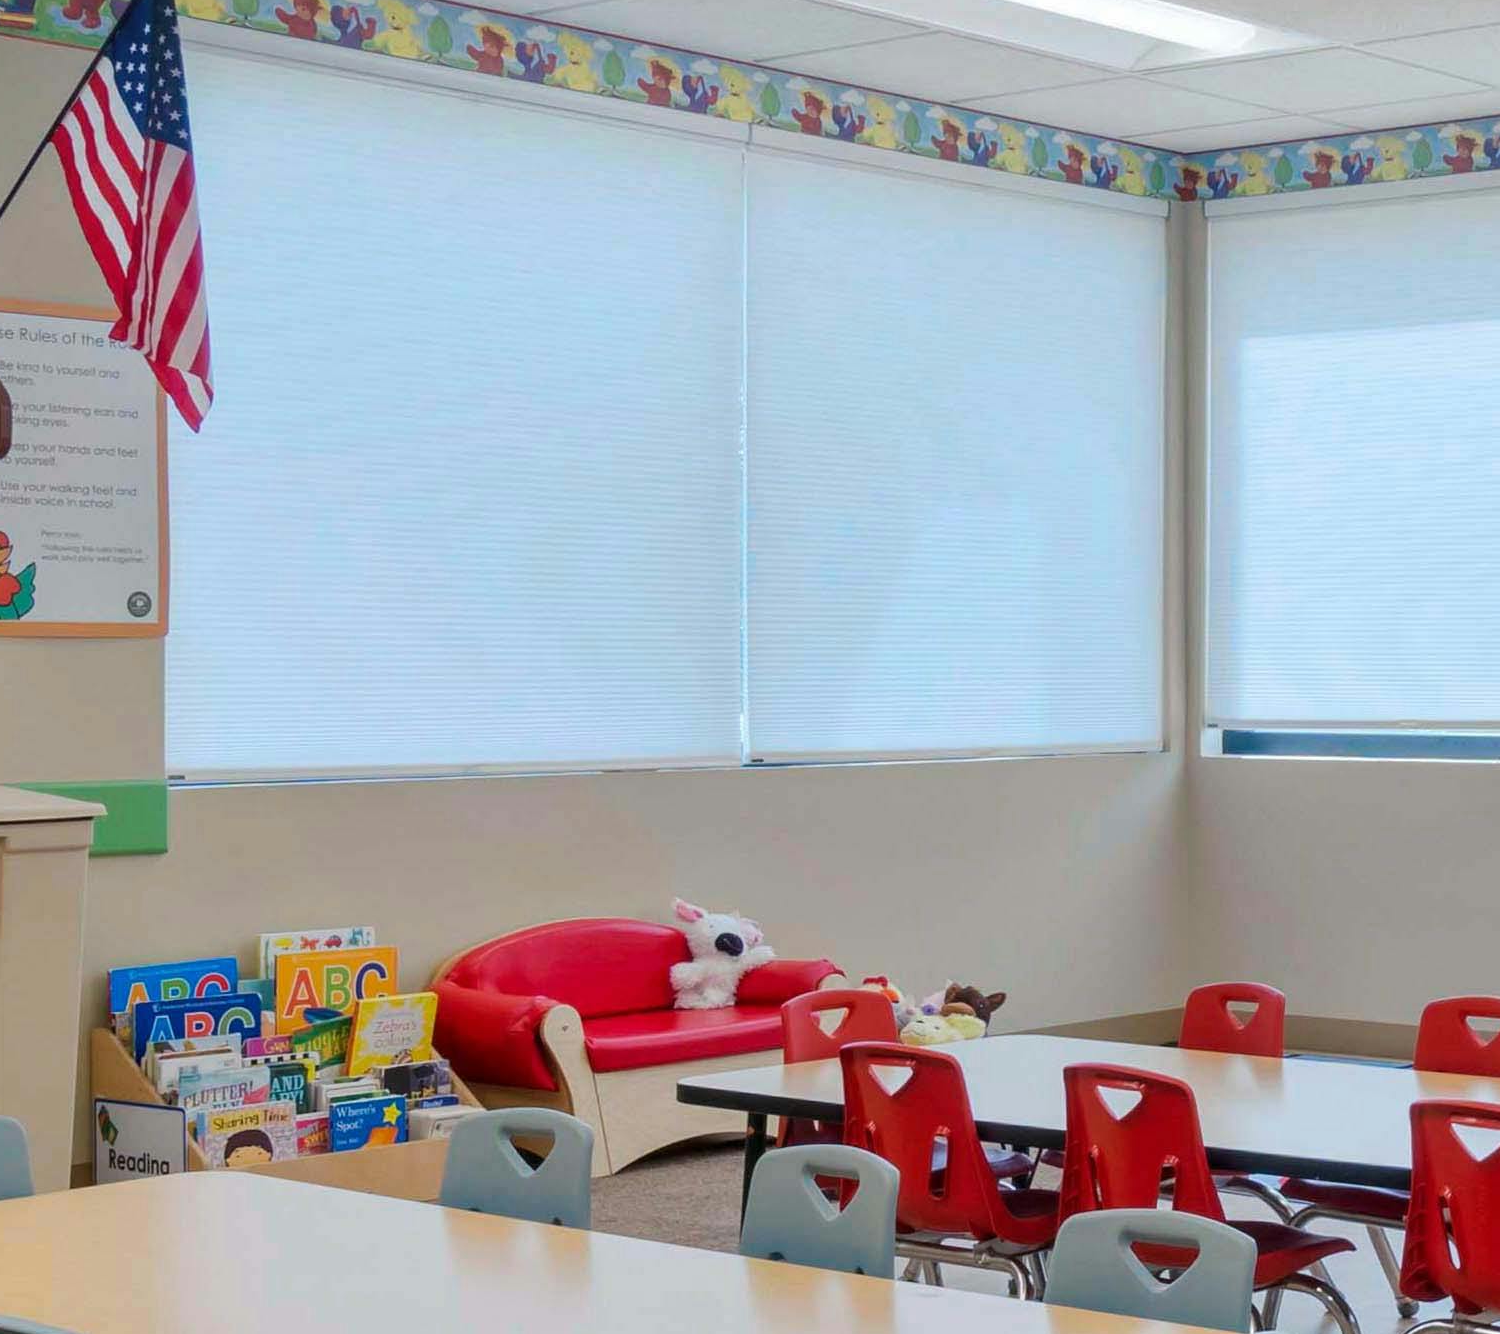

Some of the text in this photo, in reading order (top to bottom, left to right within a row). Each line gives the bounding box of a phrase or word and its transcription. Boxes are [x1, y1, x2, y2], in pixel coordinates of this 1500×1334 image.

[19, 327, 58, 343] Rules
[62, 331, 76, 345] of
[81, 333, 105, 348] the
[56, 364, 96, 378] yourself
[98, 367, 121, 380] and
[23, 403, 47, 414] your
[117, 409, 139, 420] and
[94, 446, 117, 457] and
[22, 483, 47, 495] your
[49, 483, 90, 497] walking
[115, 487, 137, 498] and
[283, 960, 387, 1019] ABC
[271, 1074, 305, 1093] AND
[336, 1103, 377, 1118] Where's
[212, 1109, 289, 1131] Sharing Time
[336, 1118, 364, 1133] Spot?
